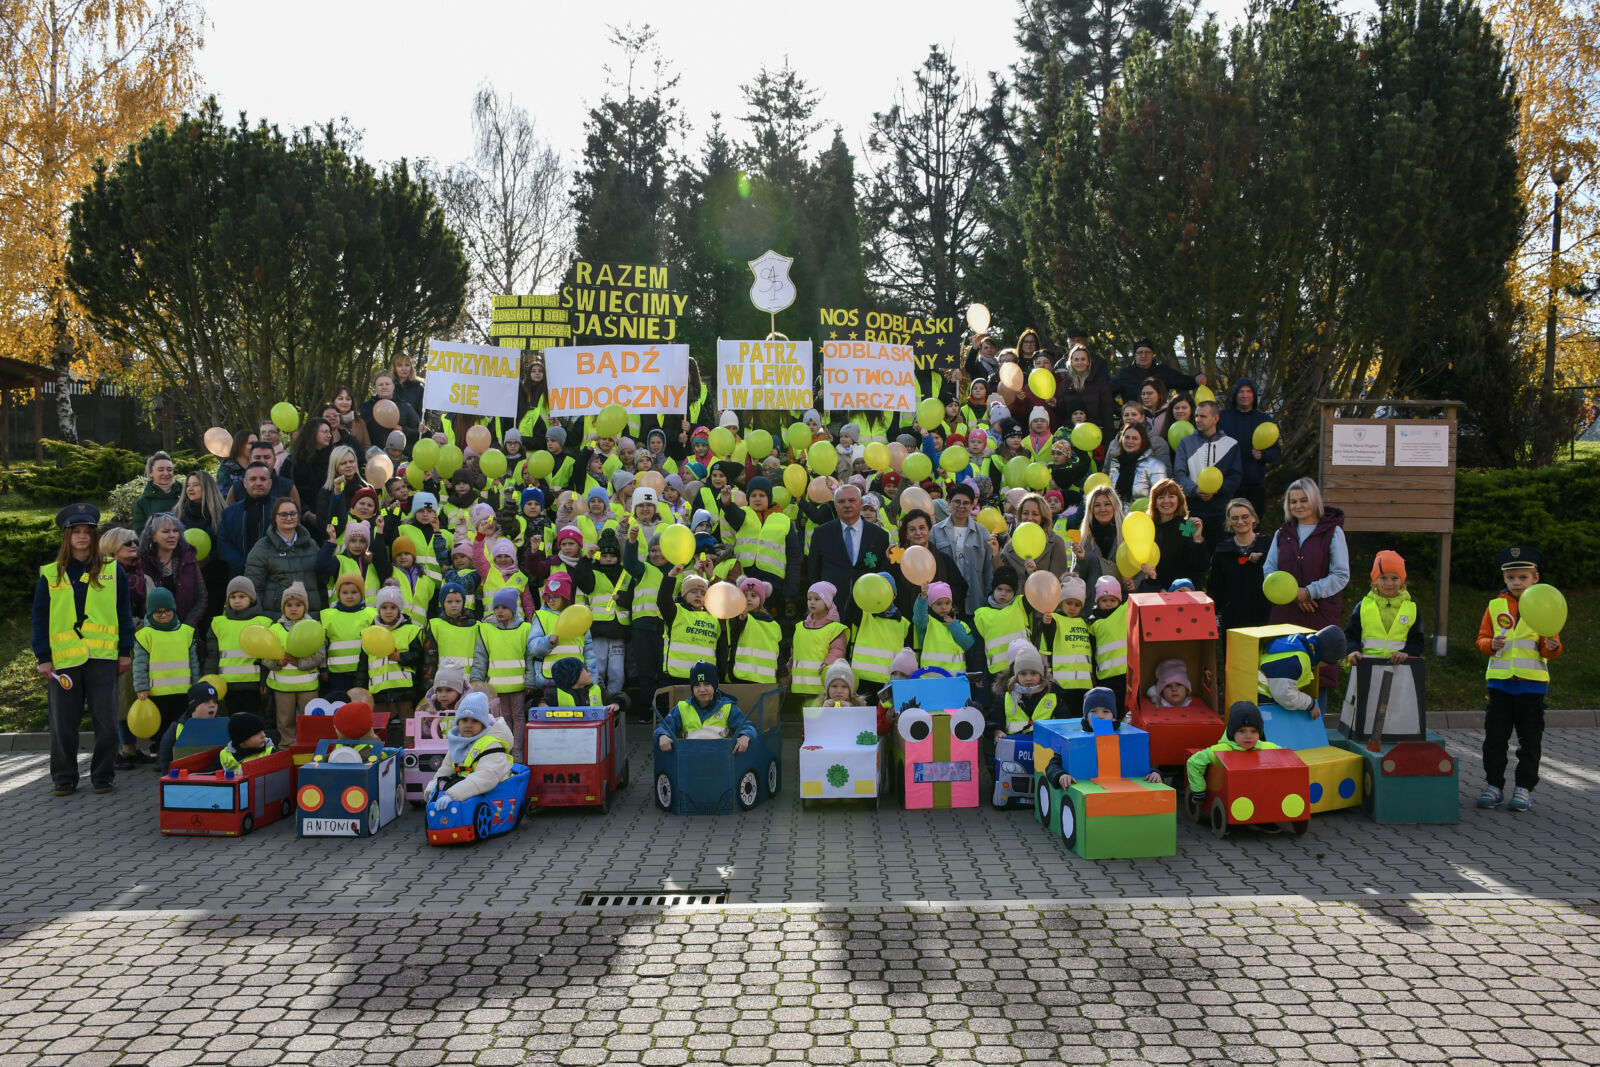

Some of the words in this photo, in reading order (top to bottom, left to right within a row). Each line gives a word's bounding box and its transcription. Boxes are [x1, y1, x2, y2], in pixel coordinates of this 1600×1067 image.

[576, 261, 668, 289] RAZEM
[561, 284, 689, 316] ŚWIECIMY
[572, 313, 676, 340] JAŚNIEJ
[820, 308, 859, 327] NOŚ
[866, 311, 954, 335] ODBLASKI
[427, 349, 520, 379] ZATRZYMAJ
[576, 346, 660, 378] BĄDŹ
[739, 342, 798, 364] PATRZ
[823, 342, 914, 363] ODBLASK
[725, 364, 744, 385] W
[750, 364, 805, 385] LEWO
[824, 368, 848, 384] TO
[853, 368, 915, 387] TWOJA
[449, 383, 480, 408] SIĘ
[547, 385, 687, 411] WIDOCZNY
[722, 388, 728, 408] I
[732, 388, 748, 408] W
[752, 388, 813, 409] PRAWO
[829, 392, 910, 410] TARCZA
[306, 820, 349, 832] ANTONI
